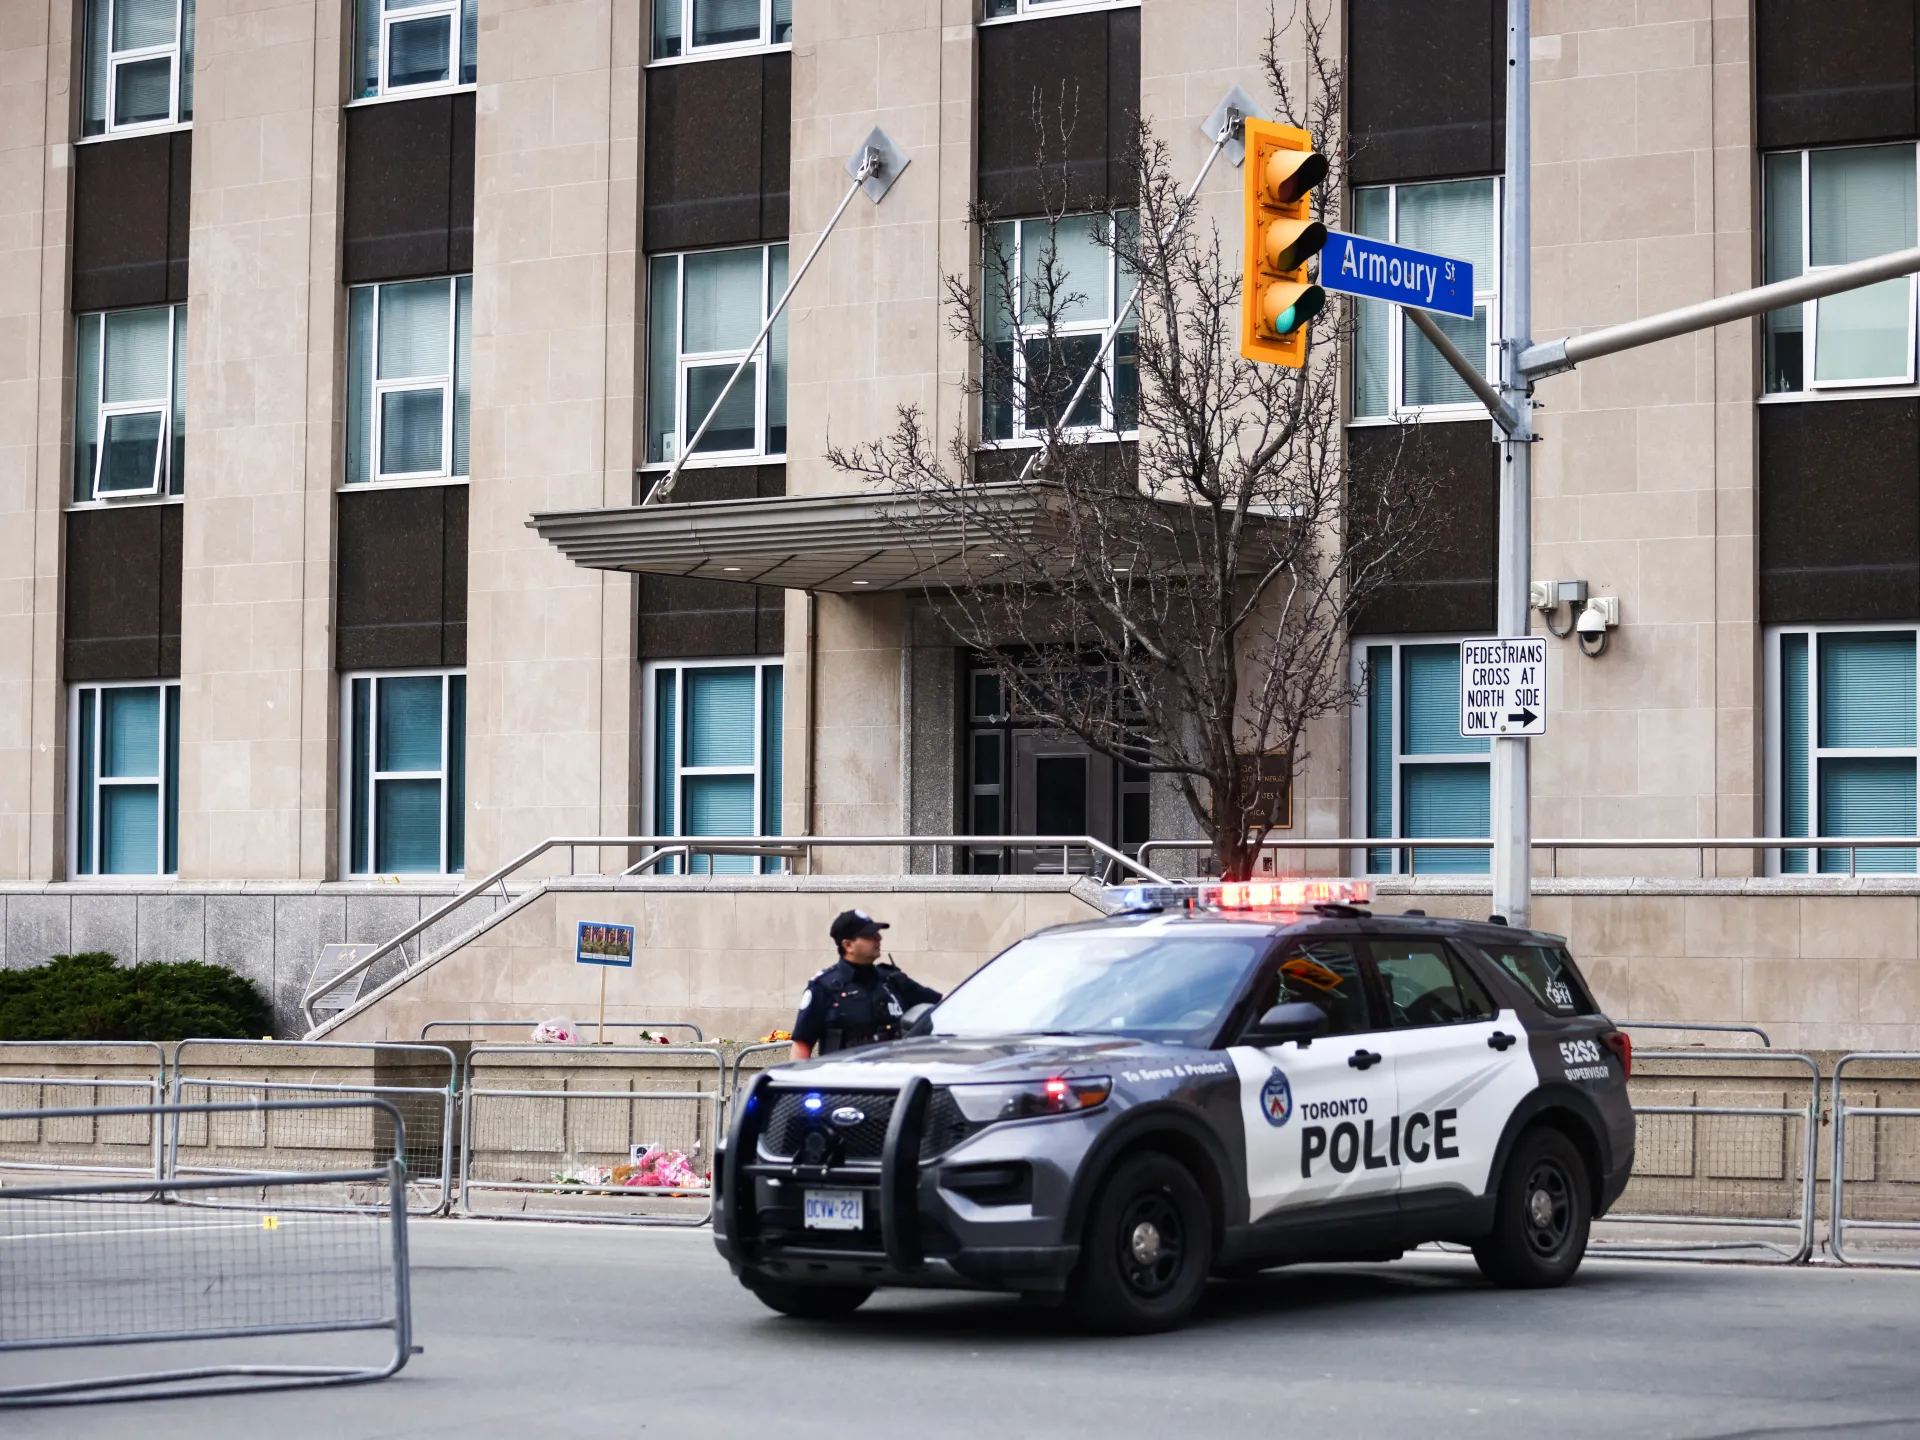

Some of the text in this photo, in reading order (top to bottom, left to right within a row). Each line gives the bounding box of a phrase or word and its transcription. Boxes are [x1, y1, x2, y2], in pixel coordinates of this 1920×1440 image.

[1341, 239, 1456, 303] Armoury St
[1466, 645, 1542, 664] PEDESTRIANS
[1473, 667, 1536, 686] CROSS AT
[1468, 689, 1540, 707] NORTH SIDE
[1468, 711, 1498, 729] ONLY
[1552, 988, 1572, 1004] 911
[1559, 1040, 1600, 1064] 52S3
[1122, 1062, 1228, 1082] To Serve & Protect
[1564, 1066, 1610, 1081] SUPERVISOR
[1300, 1097, 1368, 1121] TORONTO
[1301, 1108, 1459, 1179] POLICE
